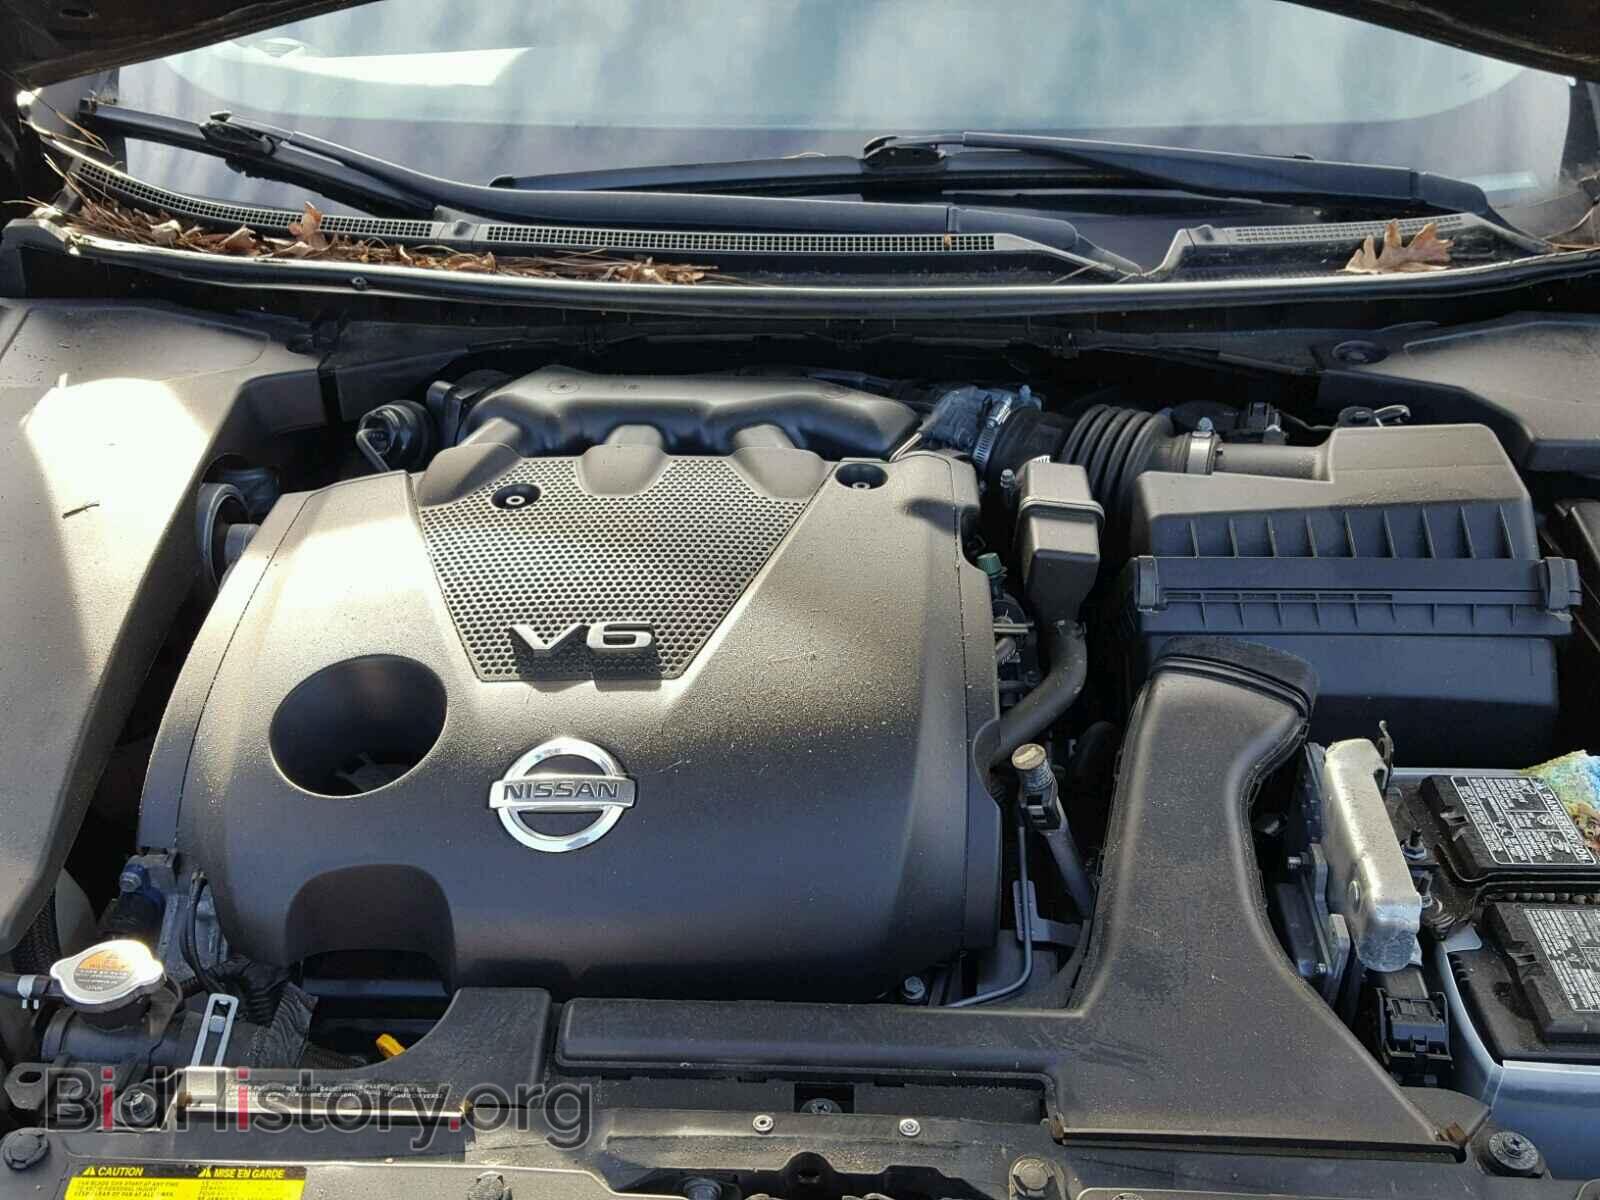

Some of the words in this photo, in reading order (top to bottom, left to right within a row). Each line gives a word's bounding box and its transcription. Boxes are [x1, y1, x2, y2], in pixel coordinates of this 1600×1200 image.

[508, 621, 652, 650] V6
[503, 781, 618, 800] NISSAN
[97, 1167, 144, 1177] CAUTION
[213, 1168, 236, 1178] MISE
[236, 1168, 251, 1179] EN
[251, 1169, 286, 1179] GARDE
